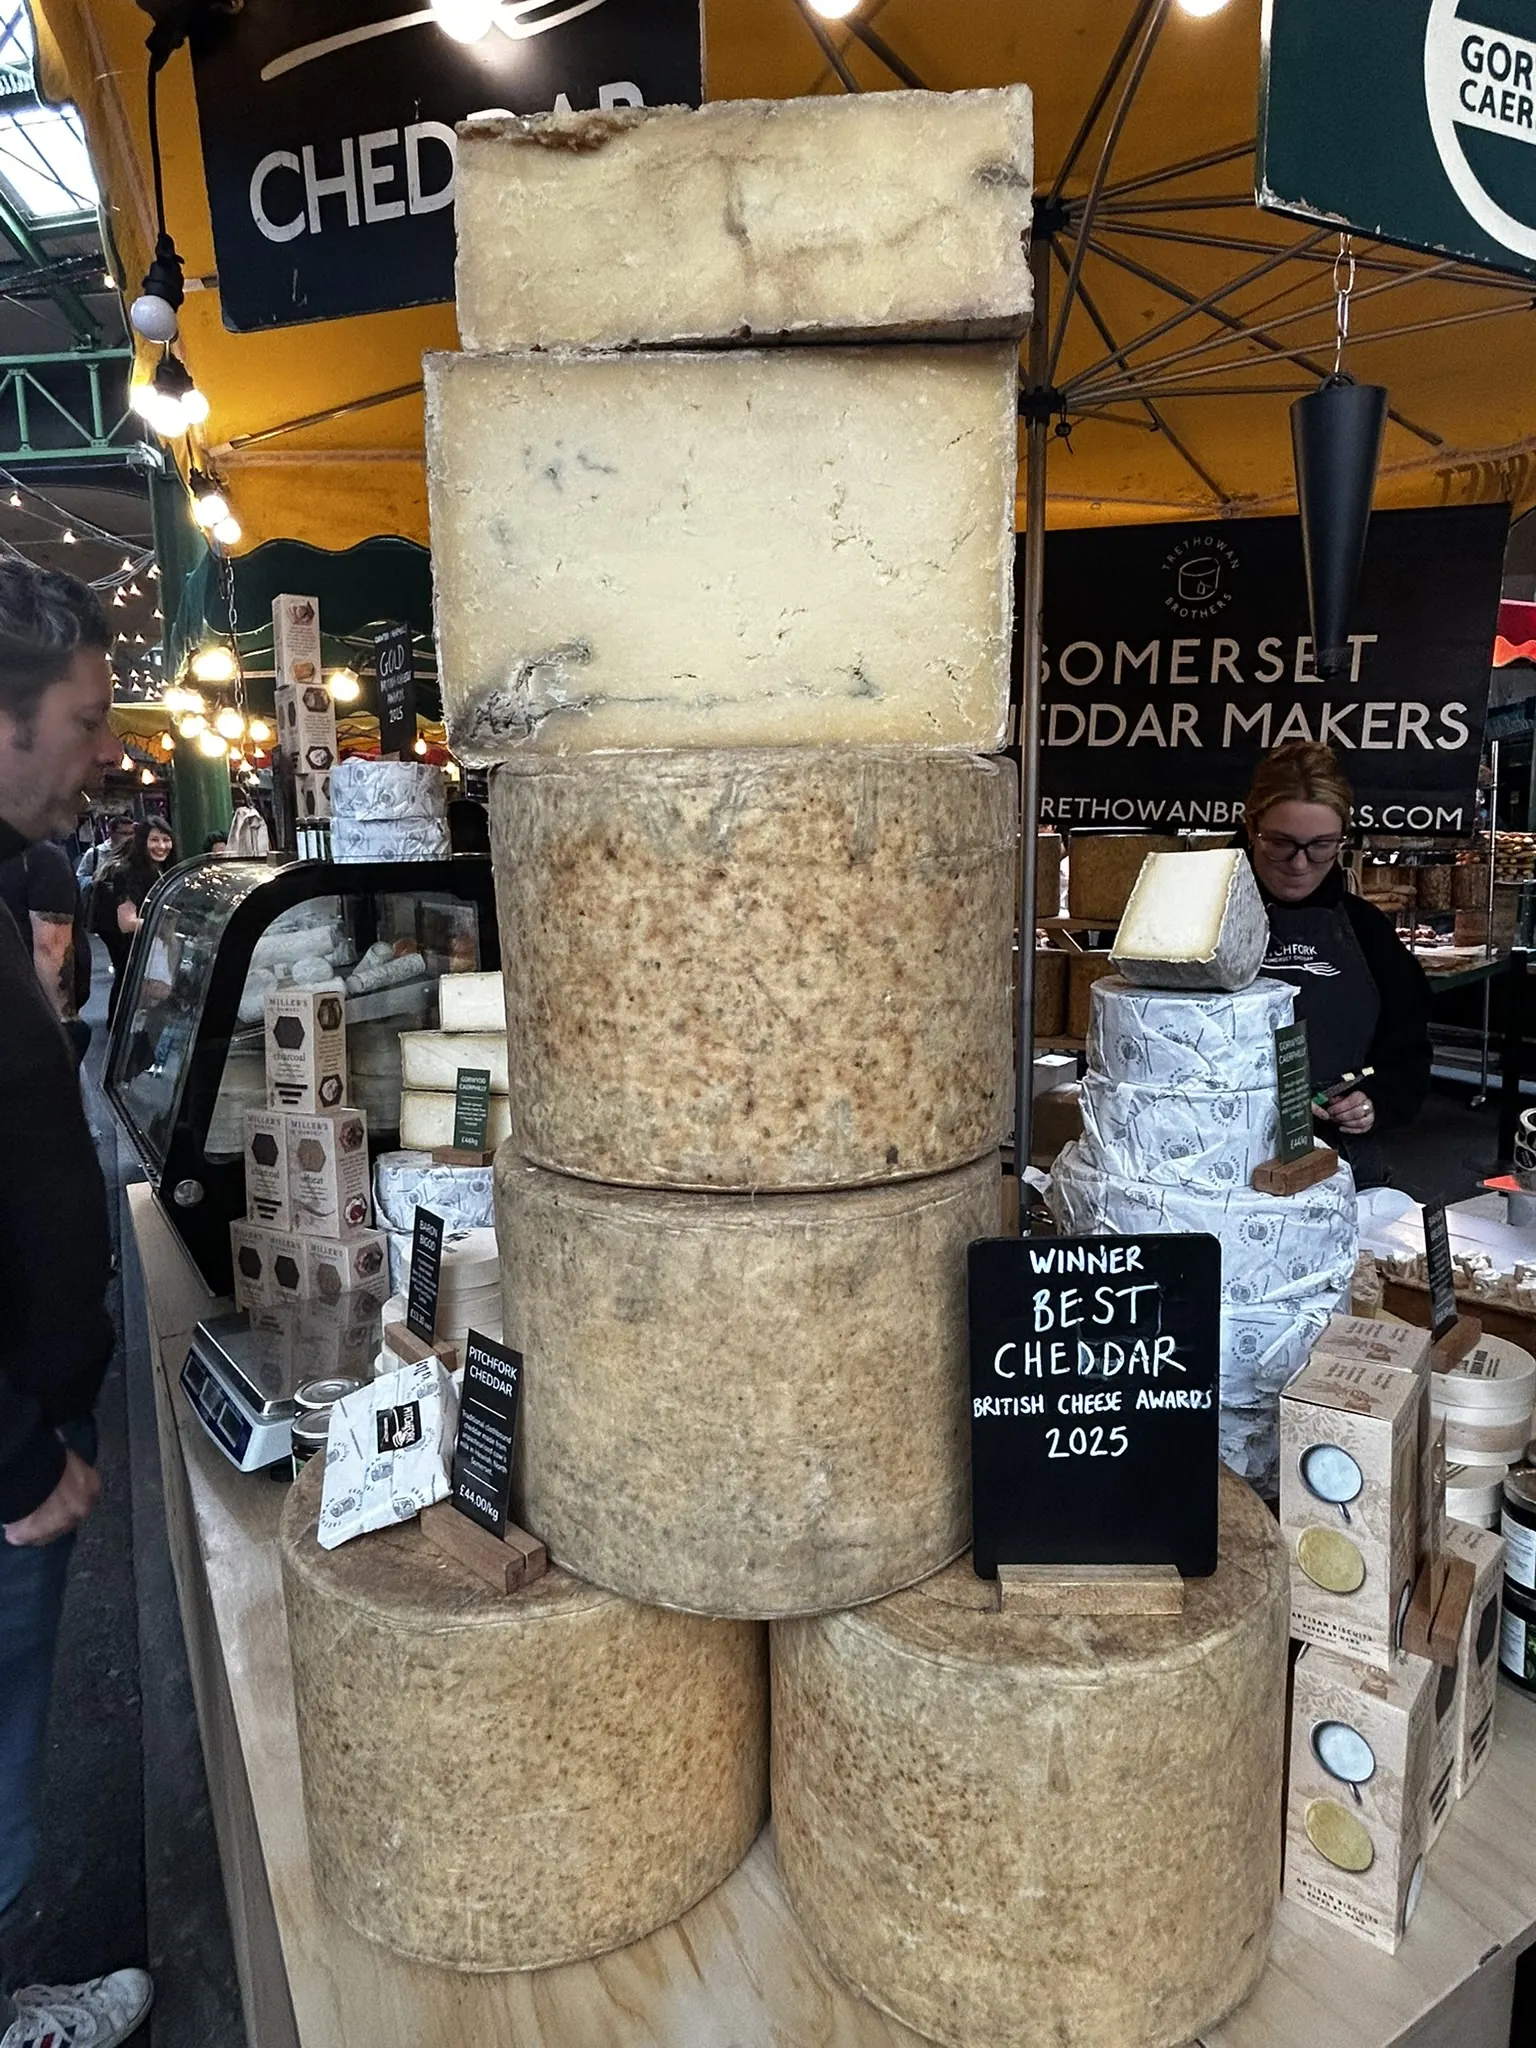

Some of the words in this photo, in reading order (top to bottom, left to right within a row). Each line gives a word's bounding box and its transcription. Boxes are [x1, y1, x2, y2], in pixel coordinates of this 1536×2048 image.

[1461, 35, 1536, 91] GOR
[1460, 79, 1536, 129] CAER
[1162, 536, 1240, 570] TRETHOWAN
[1164, 593, 1233, 620] BROTHERS
[1222, 702, 1470, 750] MAKERS
[1029, 1245, 1144, 1275] WINNER
[1033, 1284, 1159, 1332] BEST
[468, 1346, 518, 1381] PITCHFORK
[994, 1336, 1187, 1379] CHEDDAR
[469, 1366, 513, 1398] CHEDDAR
[973, 1394, 1045, 1418] BRITISH
[1057, 1391, 1123, 1415] CHEESE
[1135, 1389, 1213, 1410] AWARDS
[1045, 1426, 1129, 1459] 2025
[459, 1484, 500, 1522] £44.00/kg
[1292, 1612, 1330, 1628] ARTISAN
